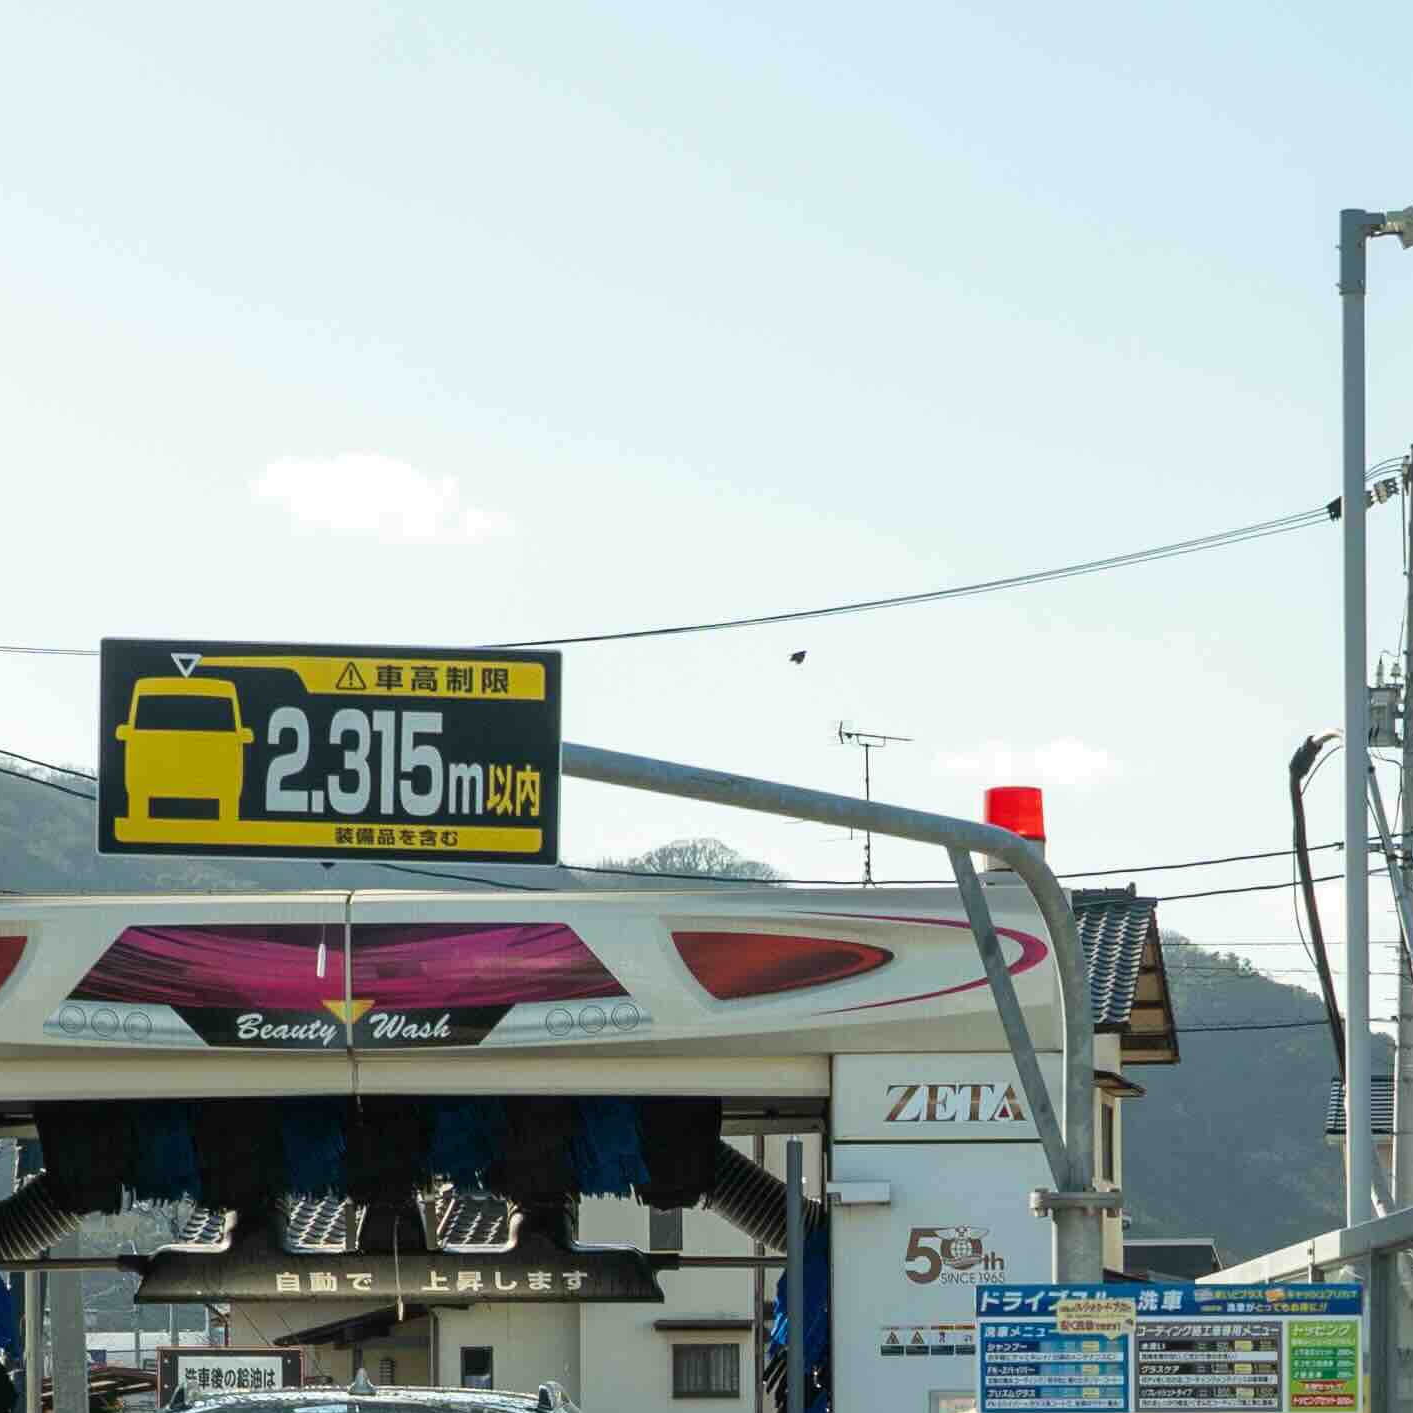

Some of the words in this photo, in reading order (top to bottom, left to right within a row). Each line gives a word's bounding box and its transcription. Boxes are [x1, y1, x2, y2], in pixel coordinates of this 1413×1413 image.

[375, 664, 509, 694] 車高制限
[335, 826, 459, 847] 装備品を含む
[236, 1012, 338, 1046] Beauty
[368, 1012, 451, 1039] Wash
[886, 1084, 1025, 1121] ZETA
[275, 1271, 373, 1293] 自動で
[422, 1271, 588, 1292] 上昇します
[941, 1272, 974, 1284] SINCE
[978, 1272, 1004, 1284] 1965
[1138, 1290, 1184, 1312] 洗車
